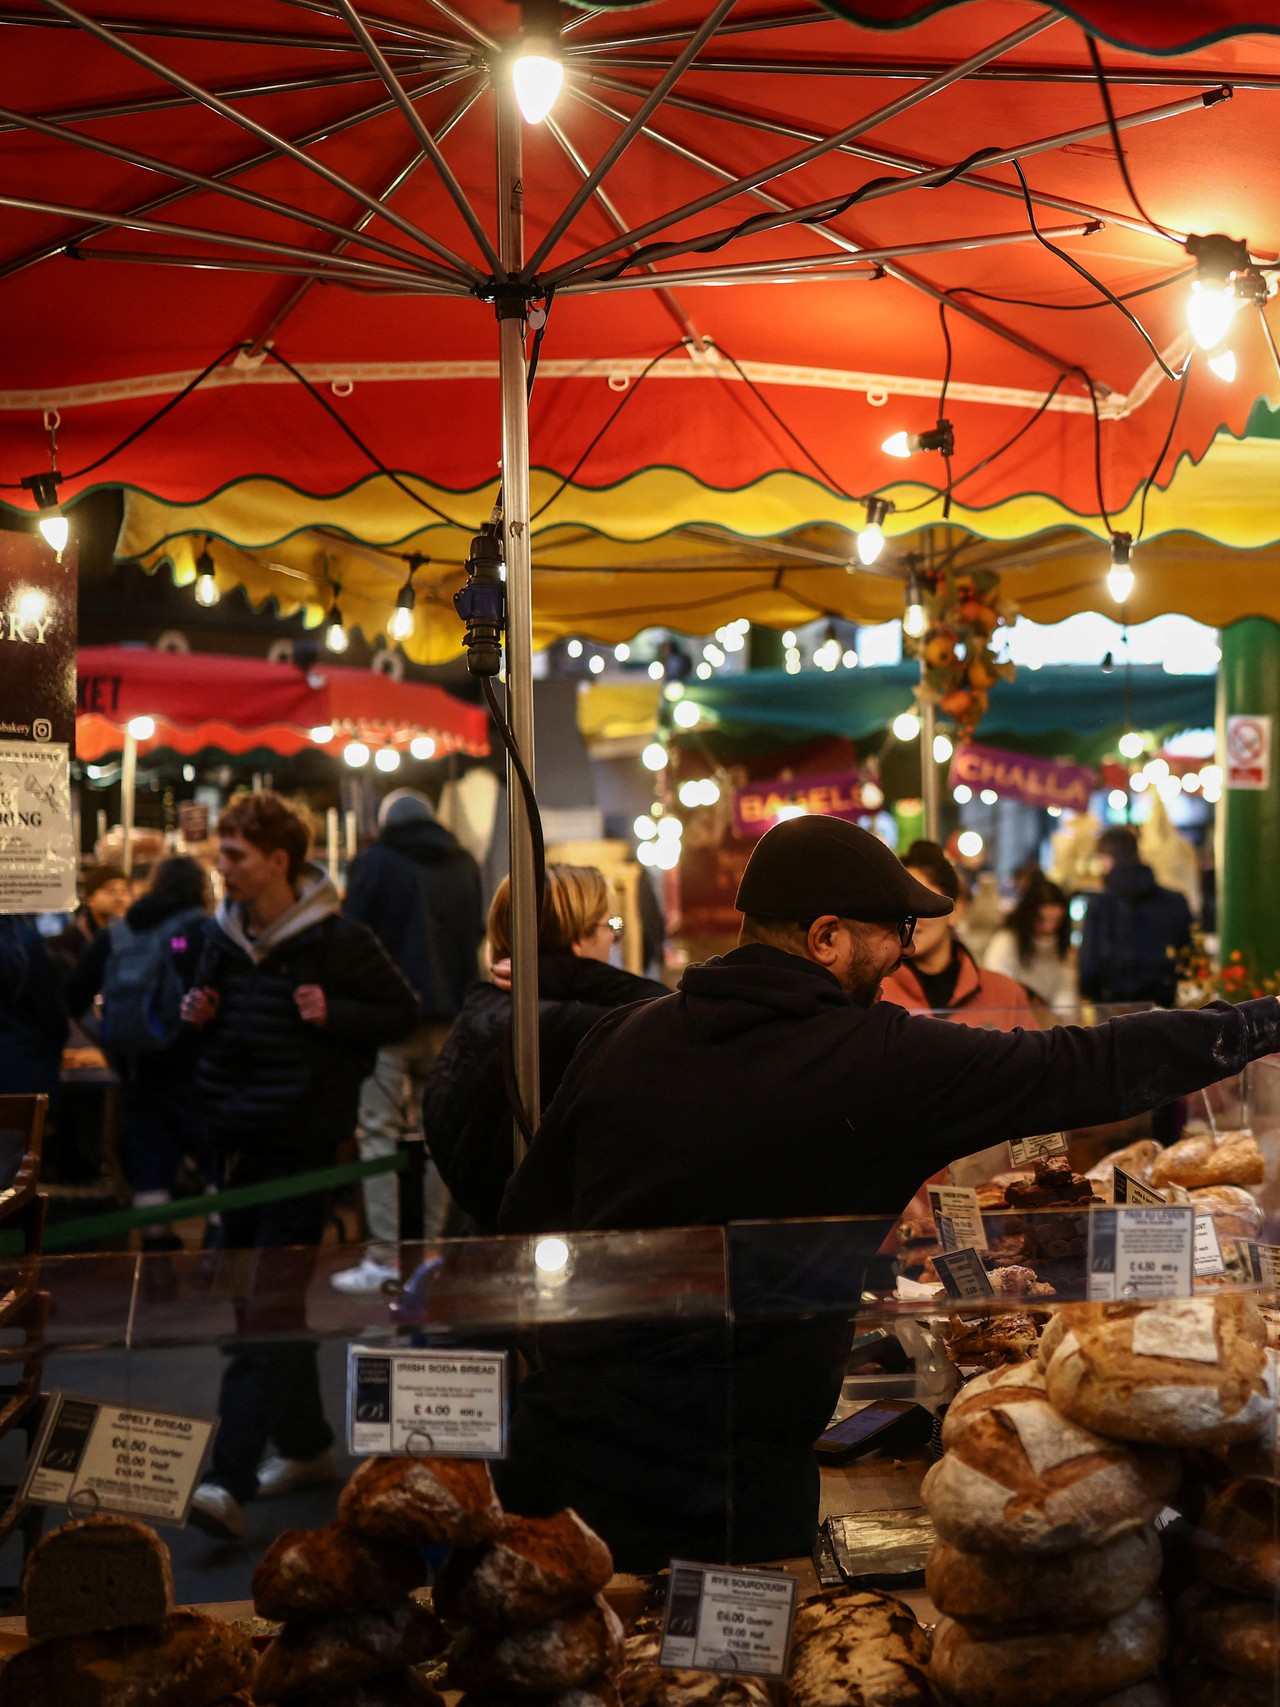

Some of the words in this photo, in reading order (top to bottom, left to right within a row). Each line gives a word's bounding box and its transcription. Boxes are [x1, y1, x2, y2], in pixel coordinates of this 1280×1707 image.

[397, 1364, 425, 1373] IRISH
[429, 1365, 457, 1374] SODA
[459, 1365, 496, 1375] BREAD
[118, 1412, 150, 1425] SPELT
[153, 1417, 192, 1433] BREAD
[711, 1576, 729, 1585] RYE
[731, 1579, 787, 1592] SOURDOUGH
